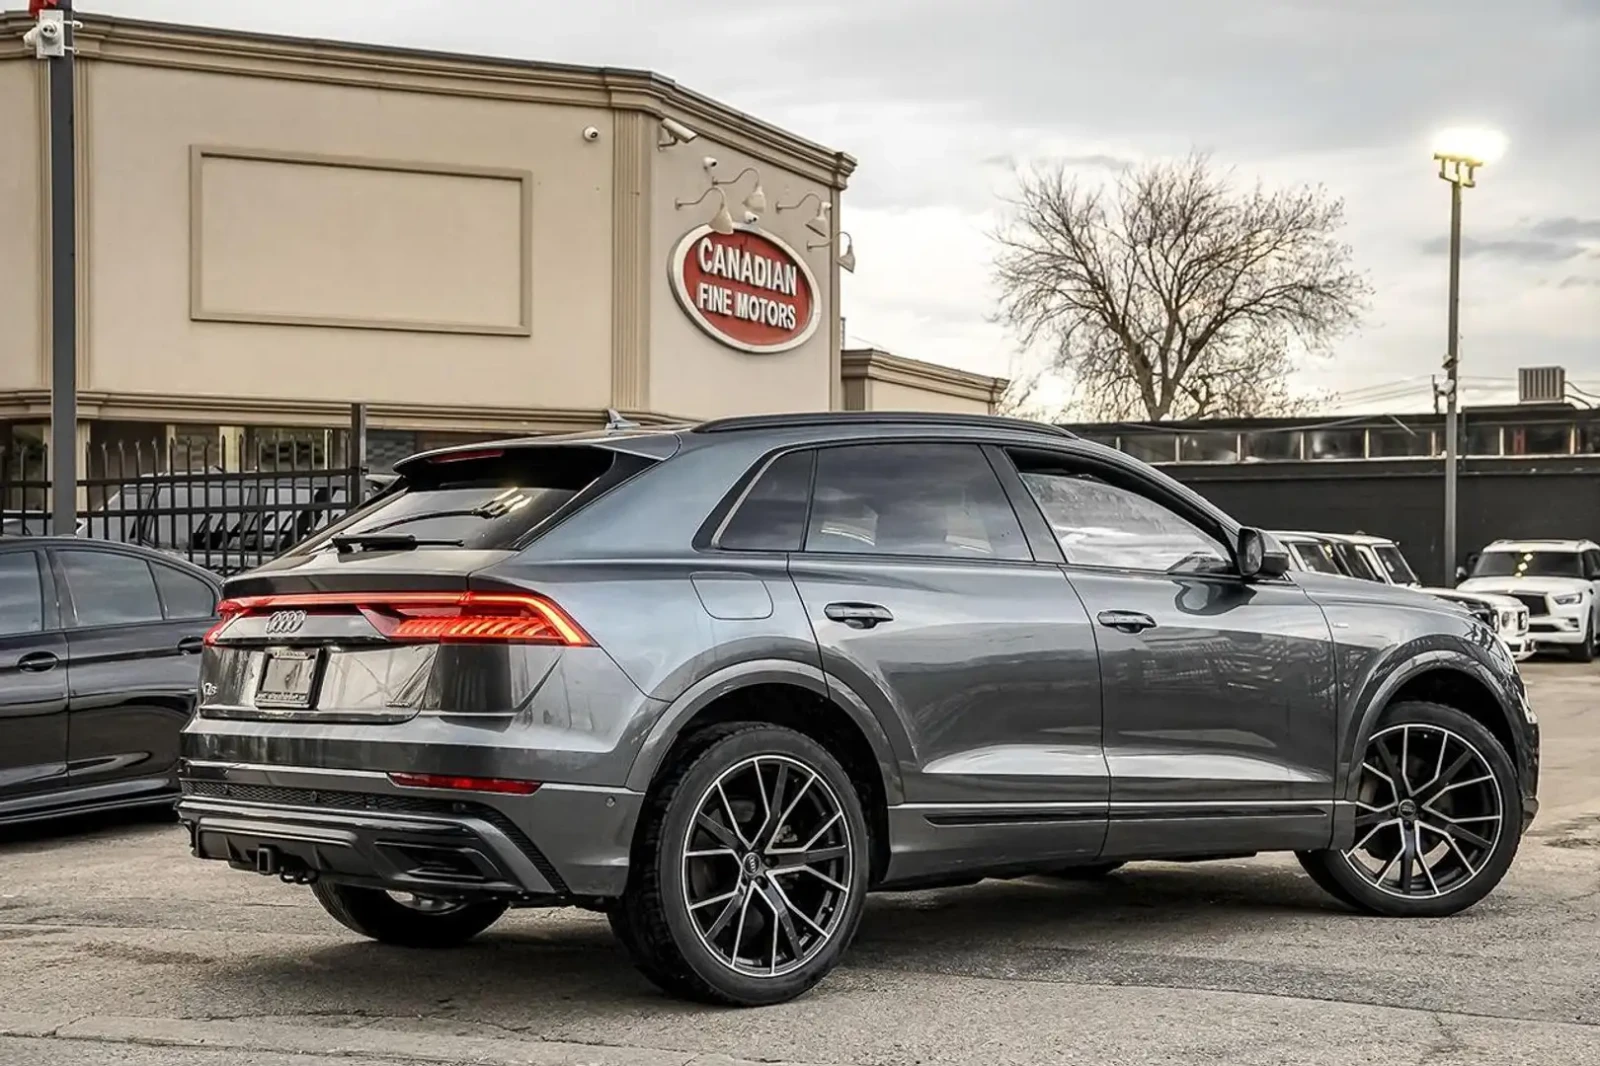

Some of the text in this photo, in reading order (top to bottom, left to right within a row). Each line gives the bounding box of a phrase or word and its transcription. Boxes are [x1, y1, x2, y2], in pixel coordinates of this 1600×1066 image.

[698, 237, 797, 296] CANADIAN
[698, 282, 796, 330] FINE MOTORS
